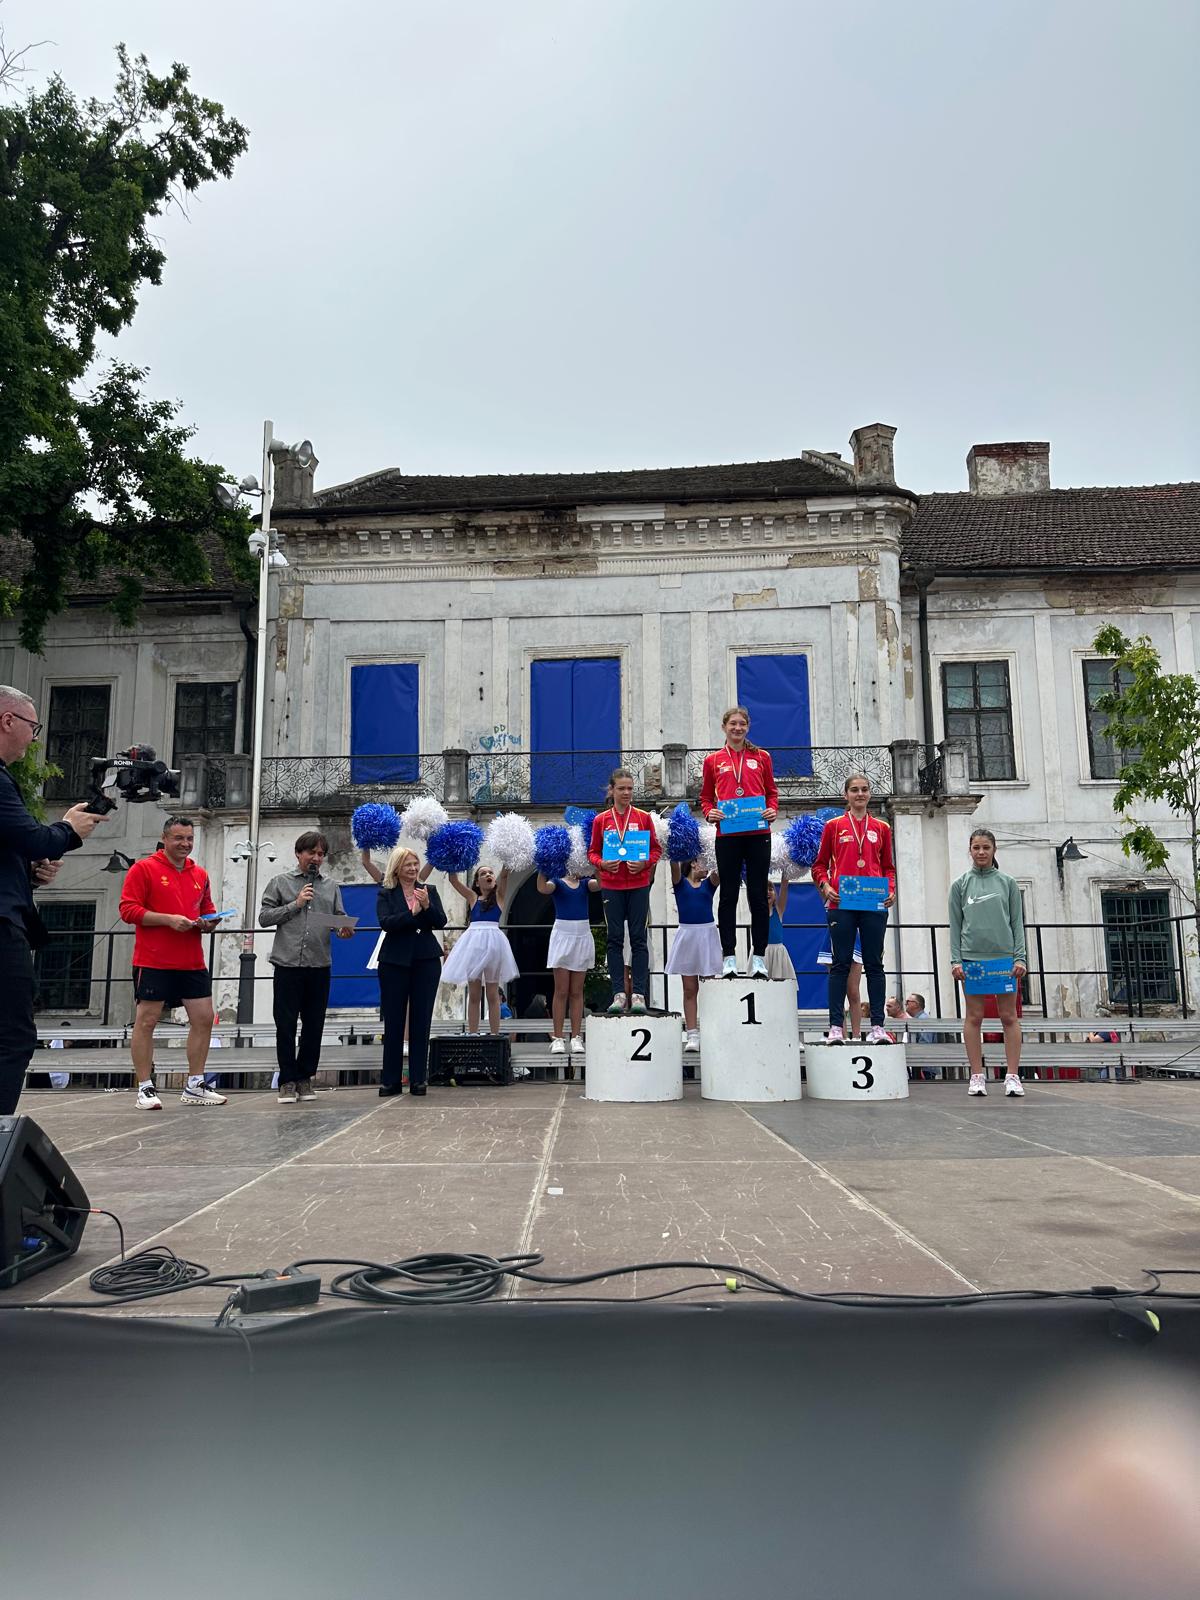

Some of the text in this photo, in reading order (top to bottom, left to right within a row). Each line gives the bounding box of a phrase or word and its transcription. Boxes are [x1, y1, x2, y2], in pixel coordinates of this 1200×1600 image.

[740, 992, 762, 1025] 1
[630, 1028, 652, 1062] 2
[851, 1055, 875, 1090] 3
